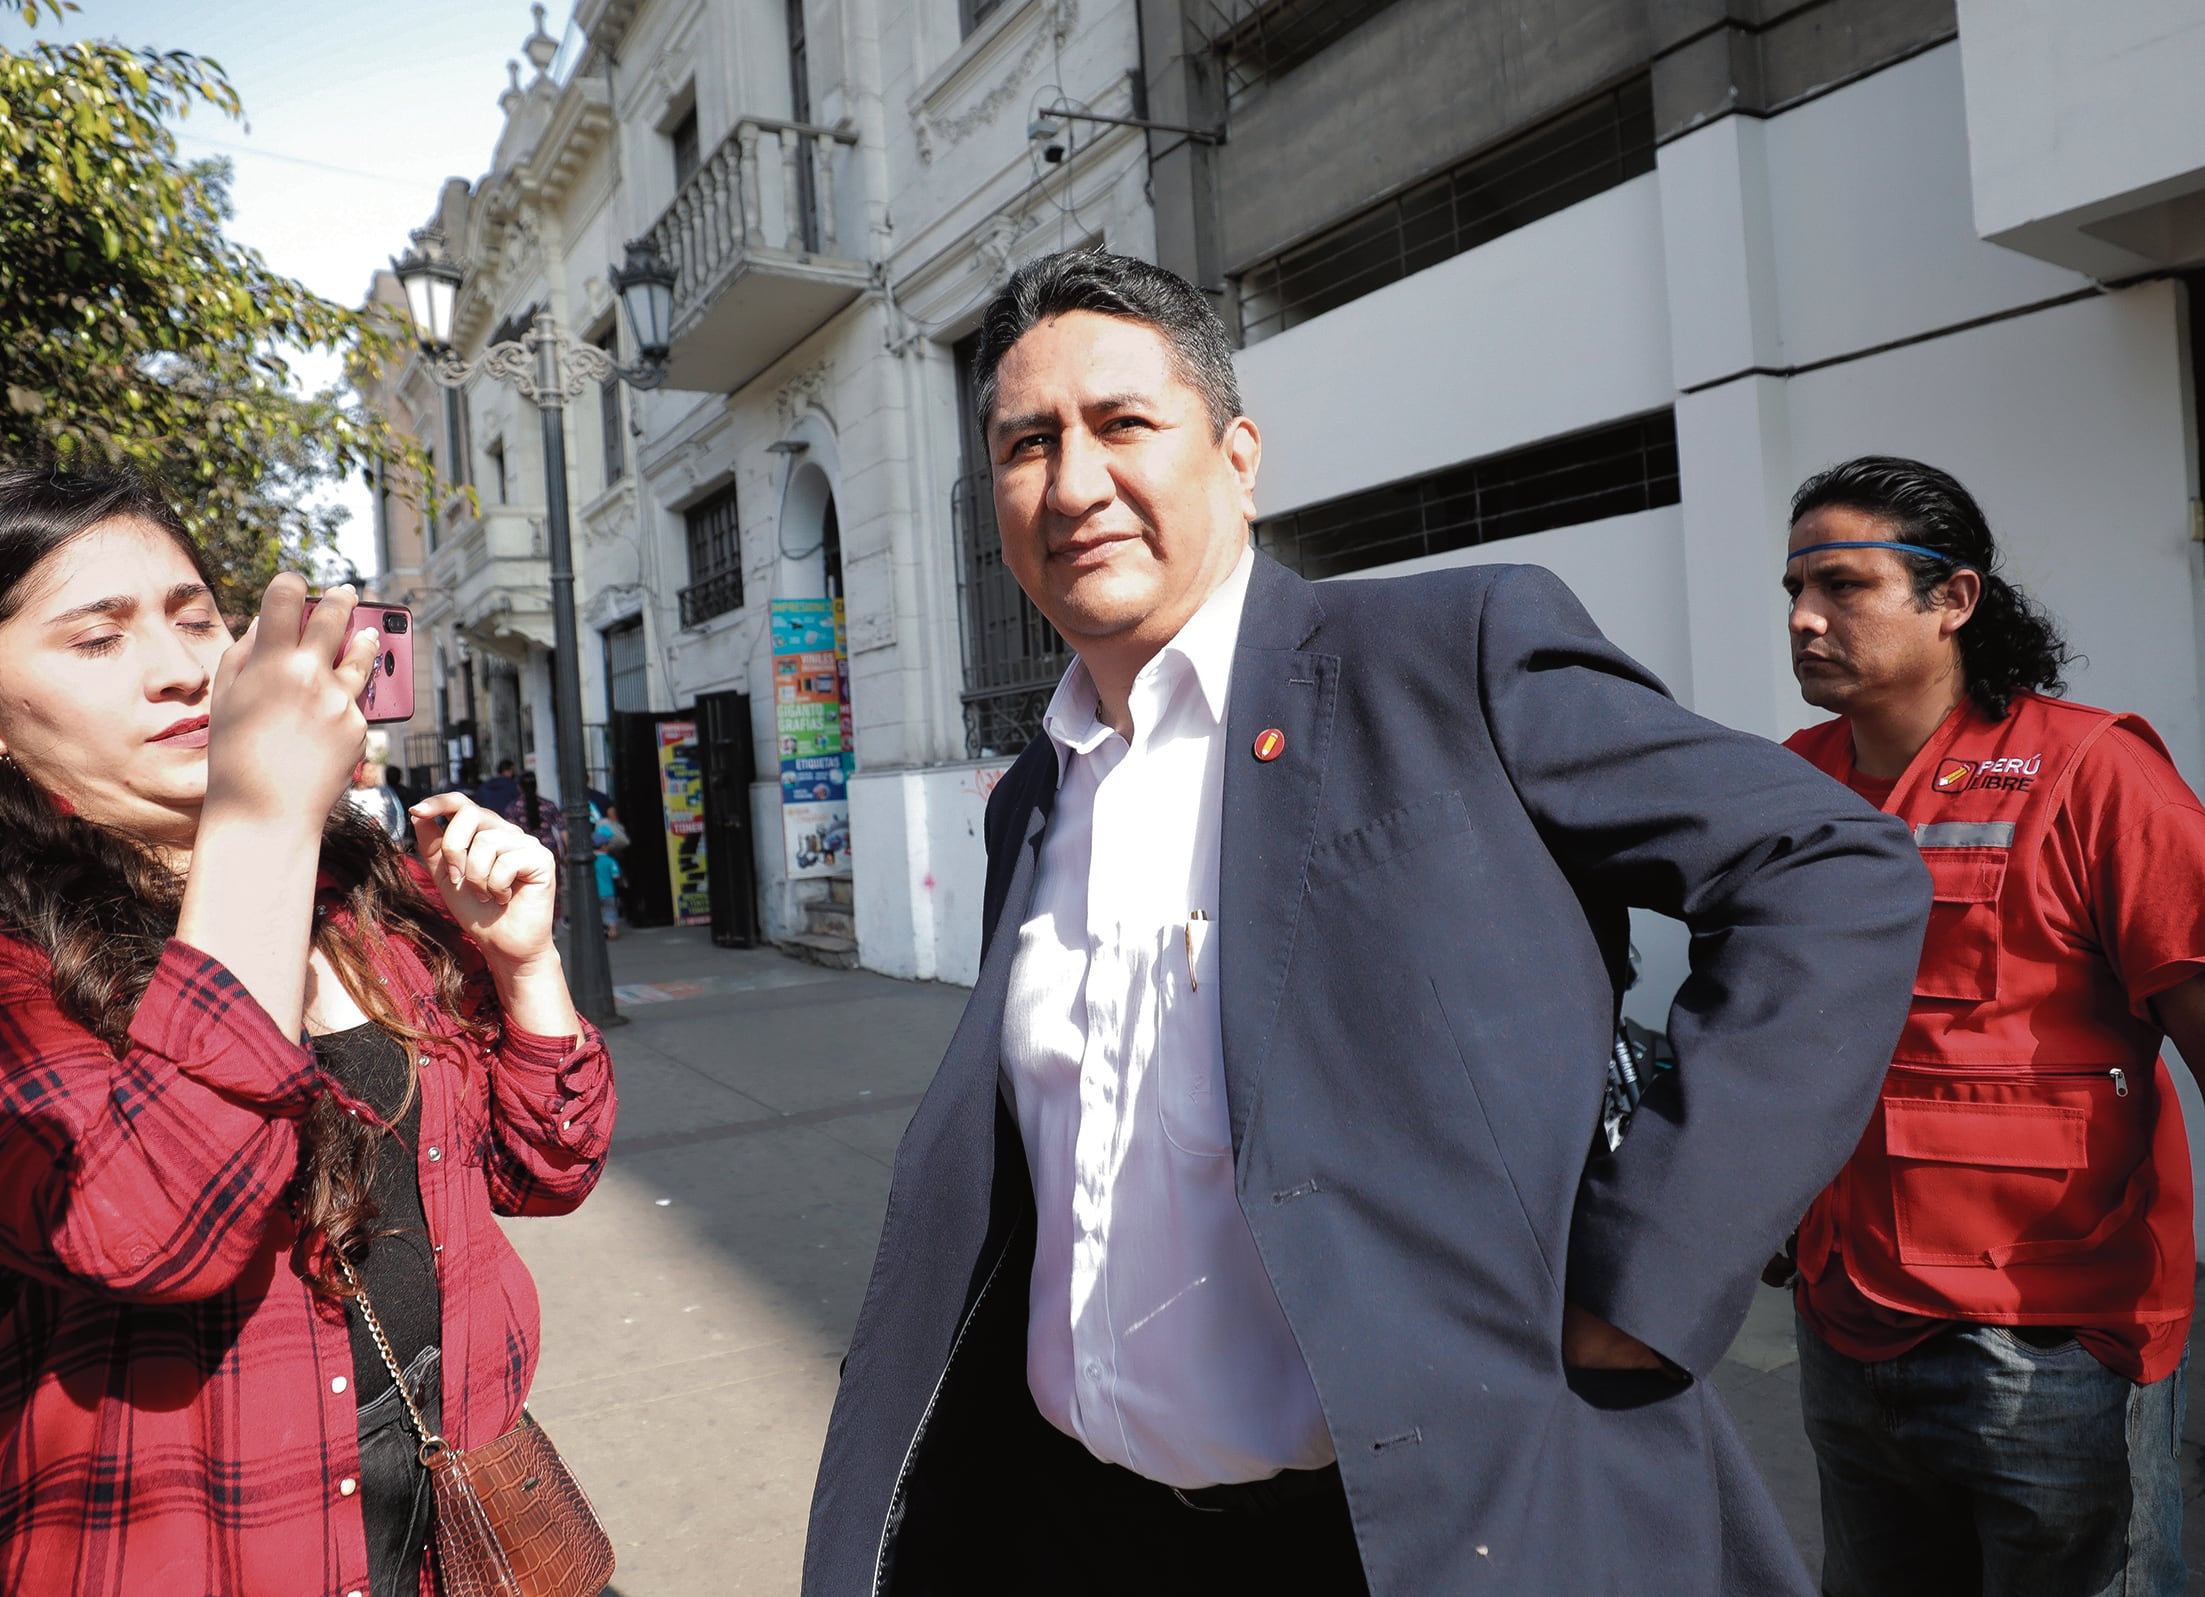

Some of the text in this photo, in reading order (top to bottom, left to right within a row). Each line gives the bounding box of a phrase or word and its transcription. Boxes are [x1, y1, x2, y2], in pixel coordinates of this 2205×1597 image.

[777, 703, 824, 718] GIGANTO
[778, 717, 825, 732] GRAFIAS
[796, 756, 840, 771] ETIQUETAS
[1976, 753, 2042, 775] PERÚ
[1968, 775, 2035, 793] LIBRE
